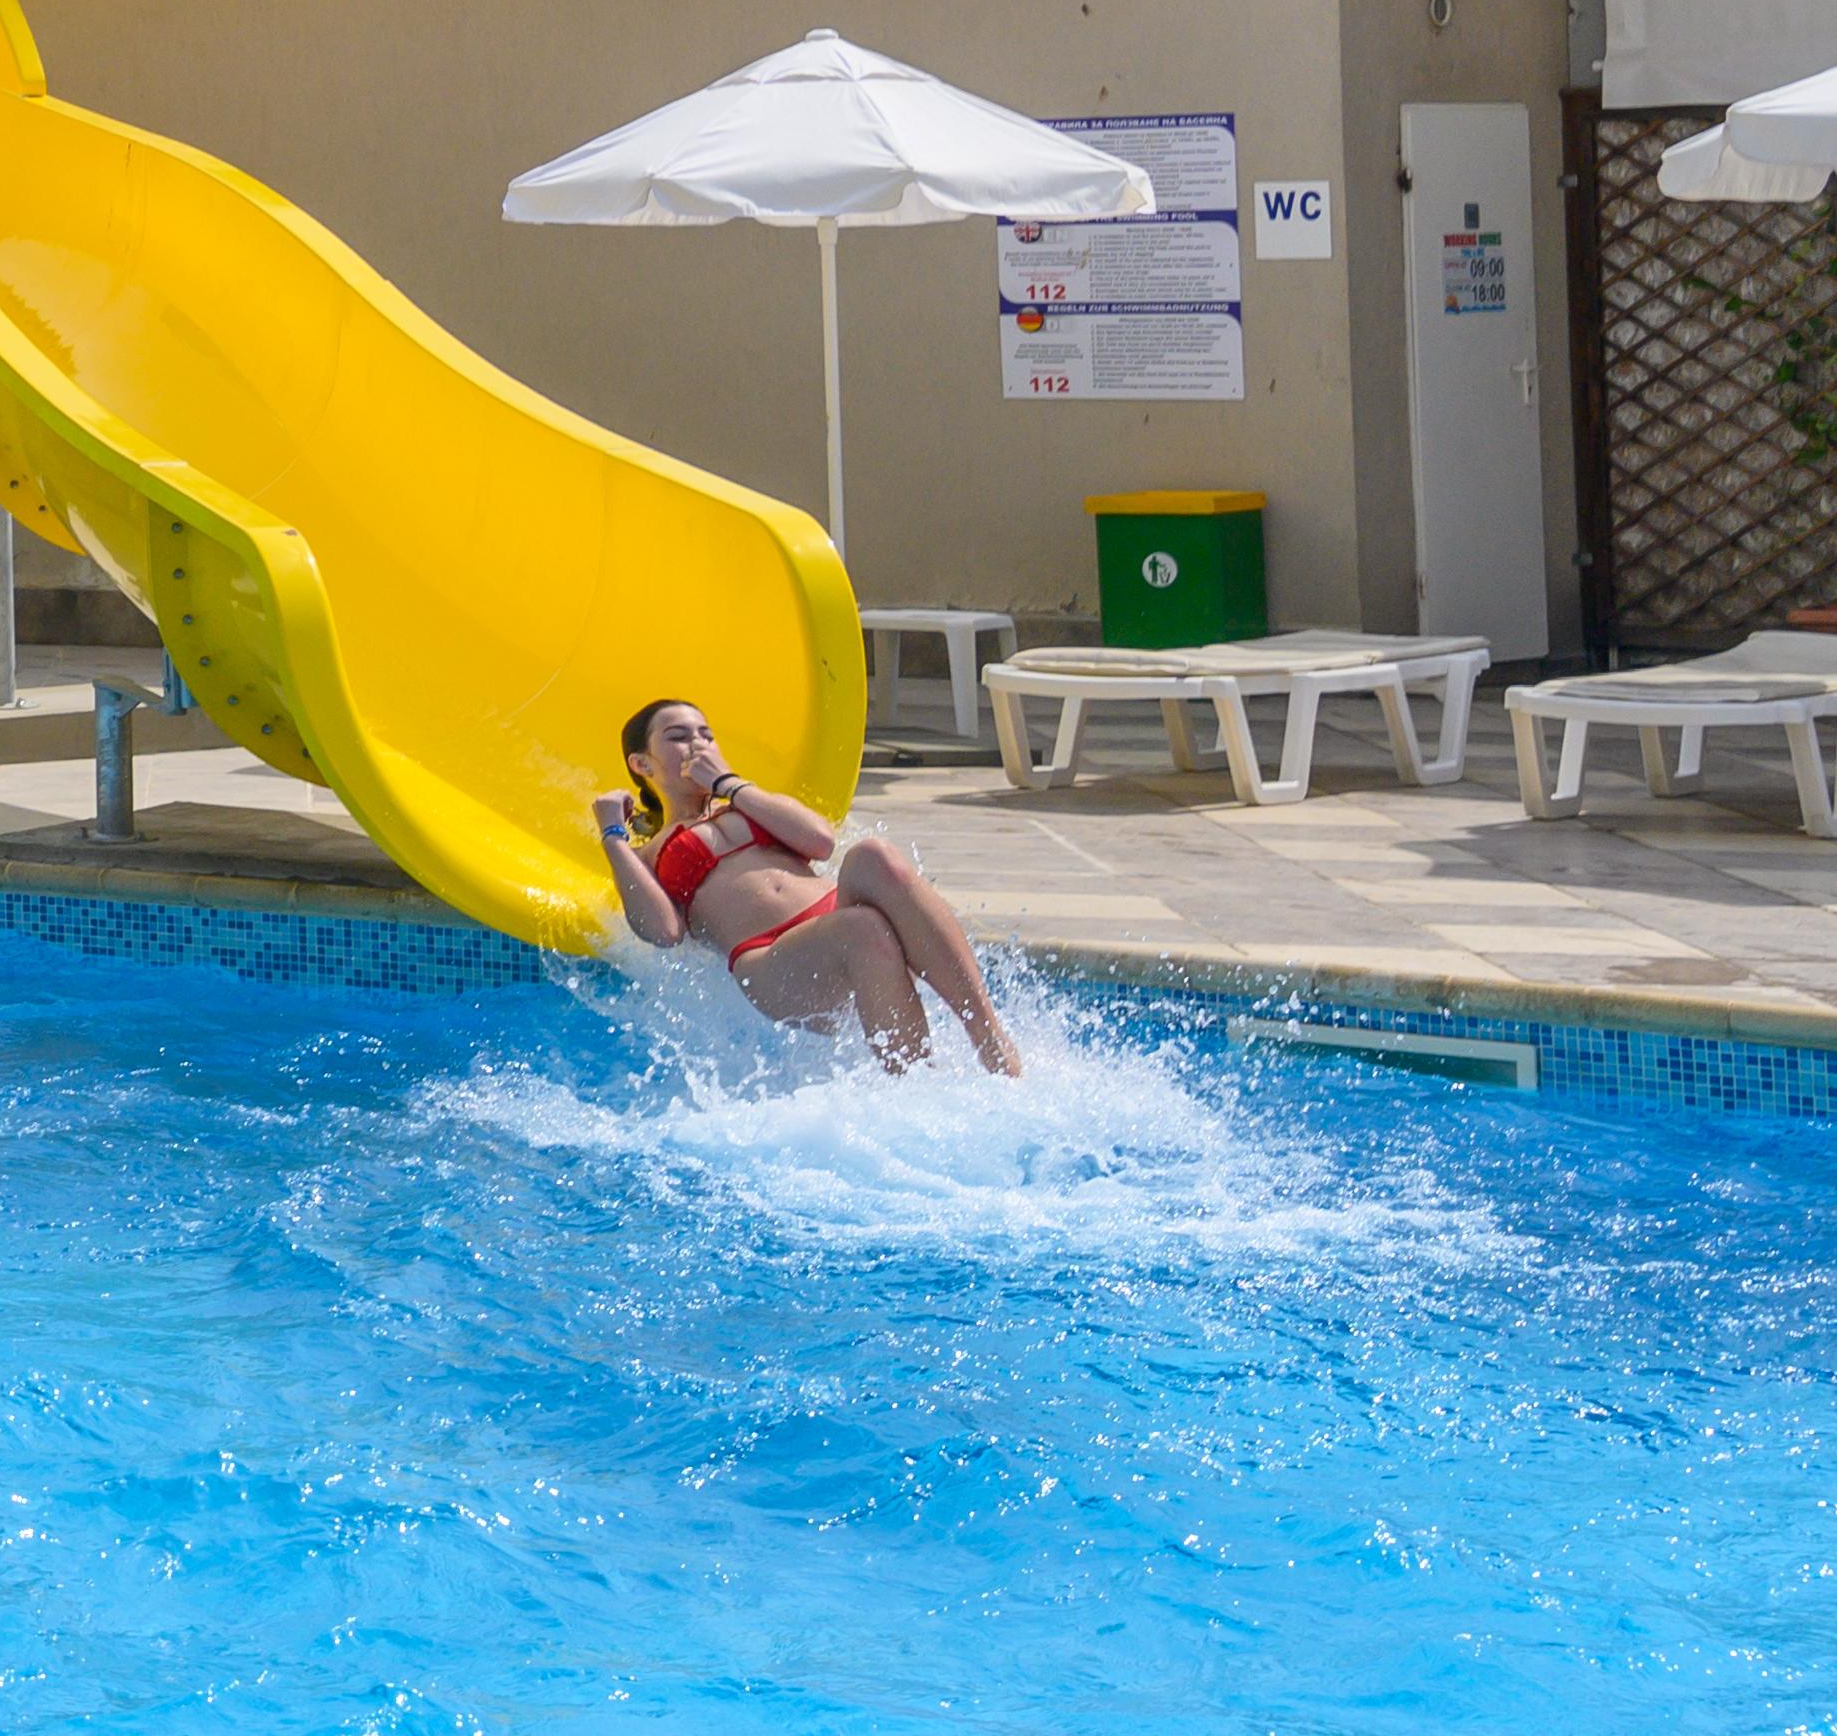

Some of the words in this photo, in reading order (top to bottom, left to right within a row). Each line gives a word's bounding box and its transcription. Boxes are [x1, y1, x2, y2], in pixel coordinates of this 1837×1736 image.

[1263, 190, 1321, 221] WC
[1171, 211, 1198, 221] POOL
[1470, 257, 1505, 279] 09:00
[1026, 284, 1066, 300] 112
[1472, 283, 1506, 303] 18:00
[1030, 376, 1070, 393] 112
